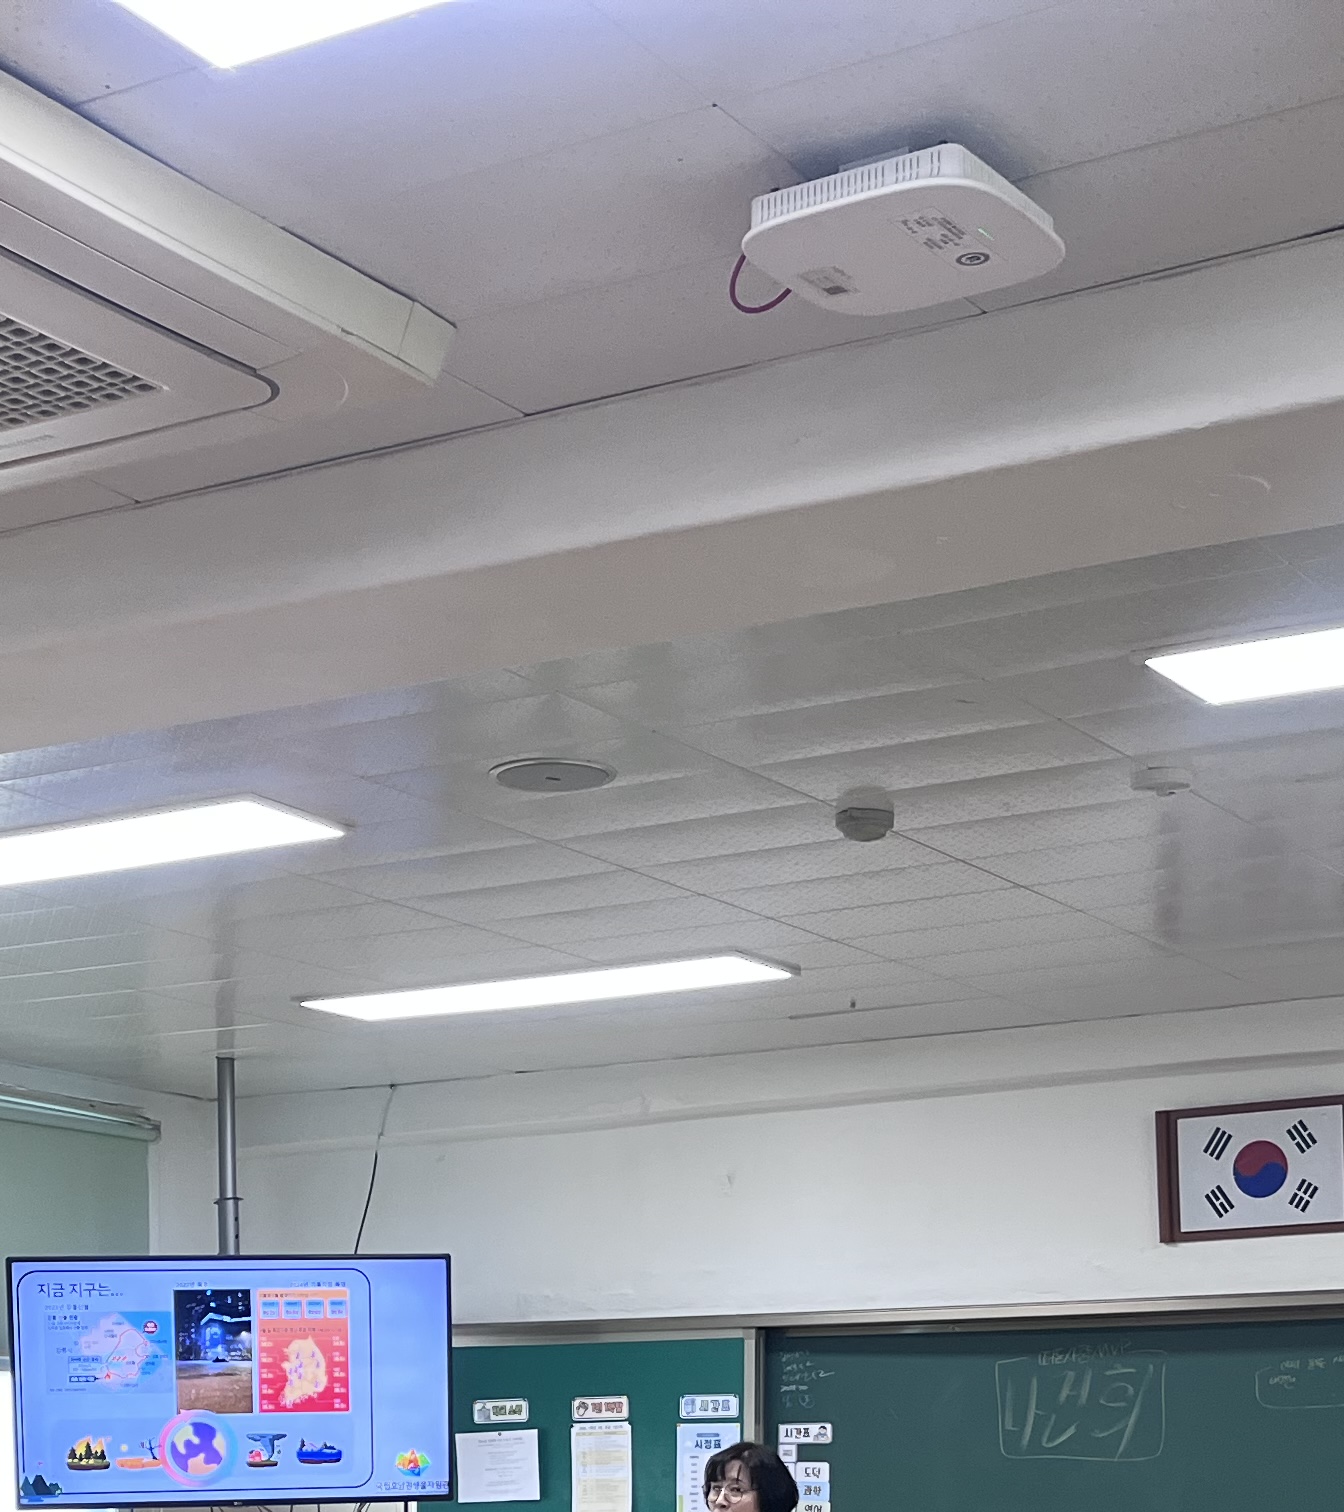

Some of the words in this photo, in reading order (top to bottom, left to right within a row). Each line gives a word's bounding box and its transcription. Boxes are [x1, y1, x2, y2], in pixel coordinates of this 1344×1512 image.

[37, 1283, 65, 1297] 지금
[784, 1427, 811, 1438] 시간표
[694, 1439, 722, 1450] 시정표
[804, 1466, 821, 1479] 도덕
[803, 1484, 822, 1497] 과학
